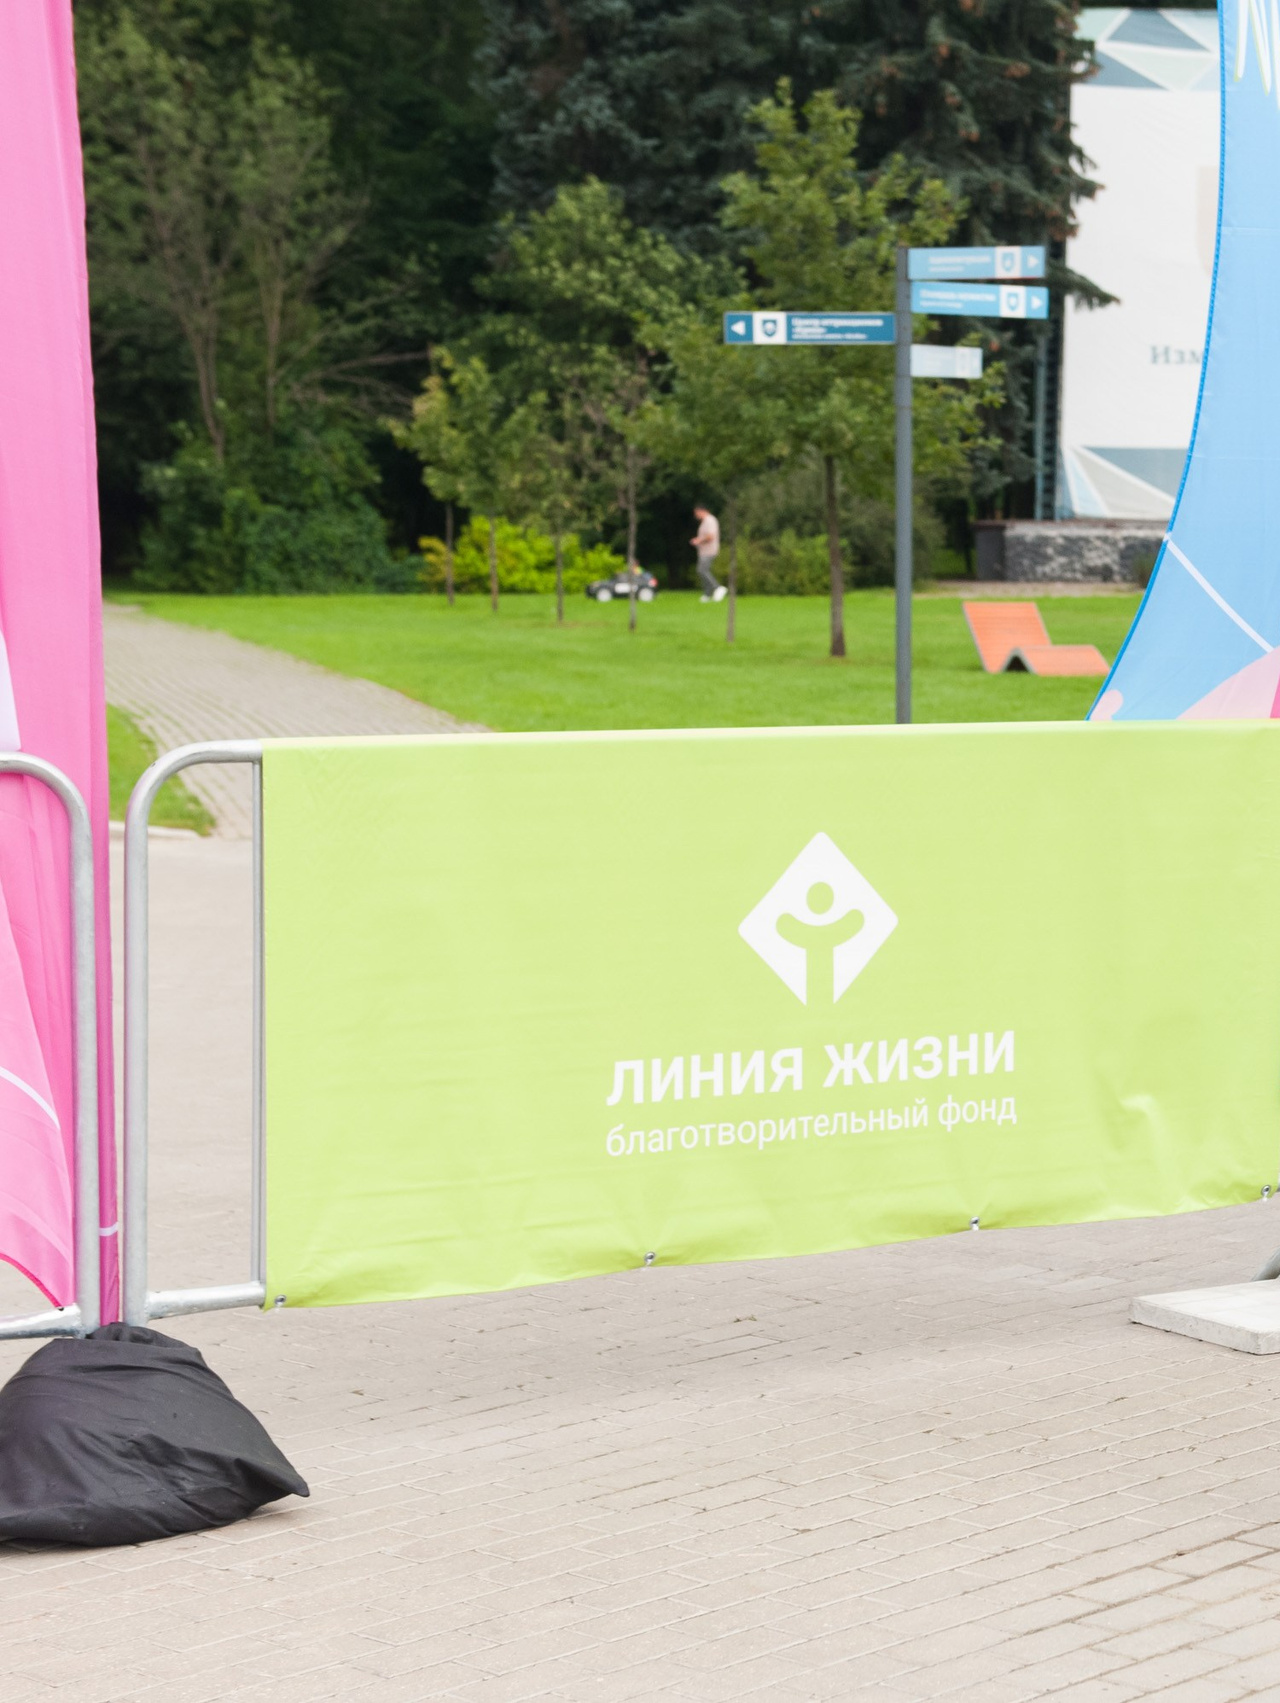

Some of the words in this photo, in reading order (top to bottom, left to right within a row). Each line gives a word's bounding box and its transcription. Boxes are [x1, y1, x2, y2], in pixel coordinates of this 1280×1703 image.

[606, 1047, 803, 1106] ЛИНИЯ
[823, 1030, 1015, 1088] ЖИЗНИ
[606, 1098, 929, 1157] благотворительный
[938, 1095, 1017, 1132] фонд
